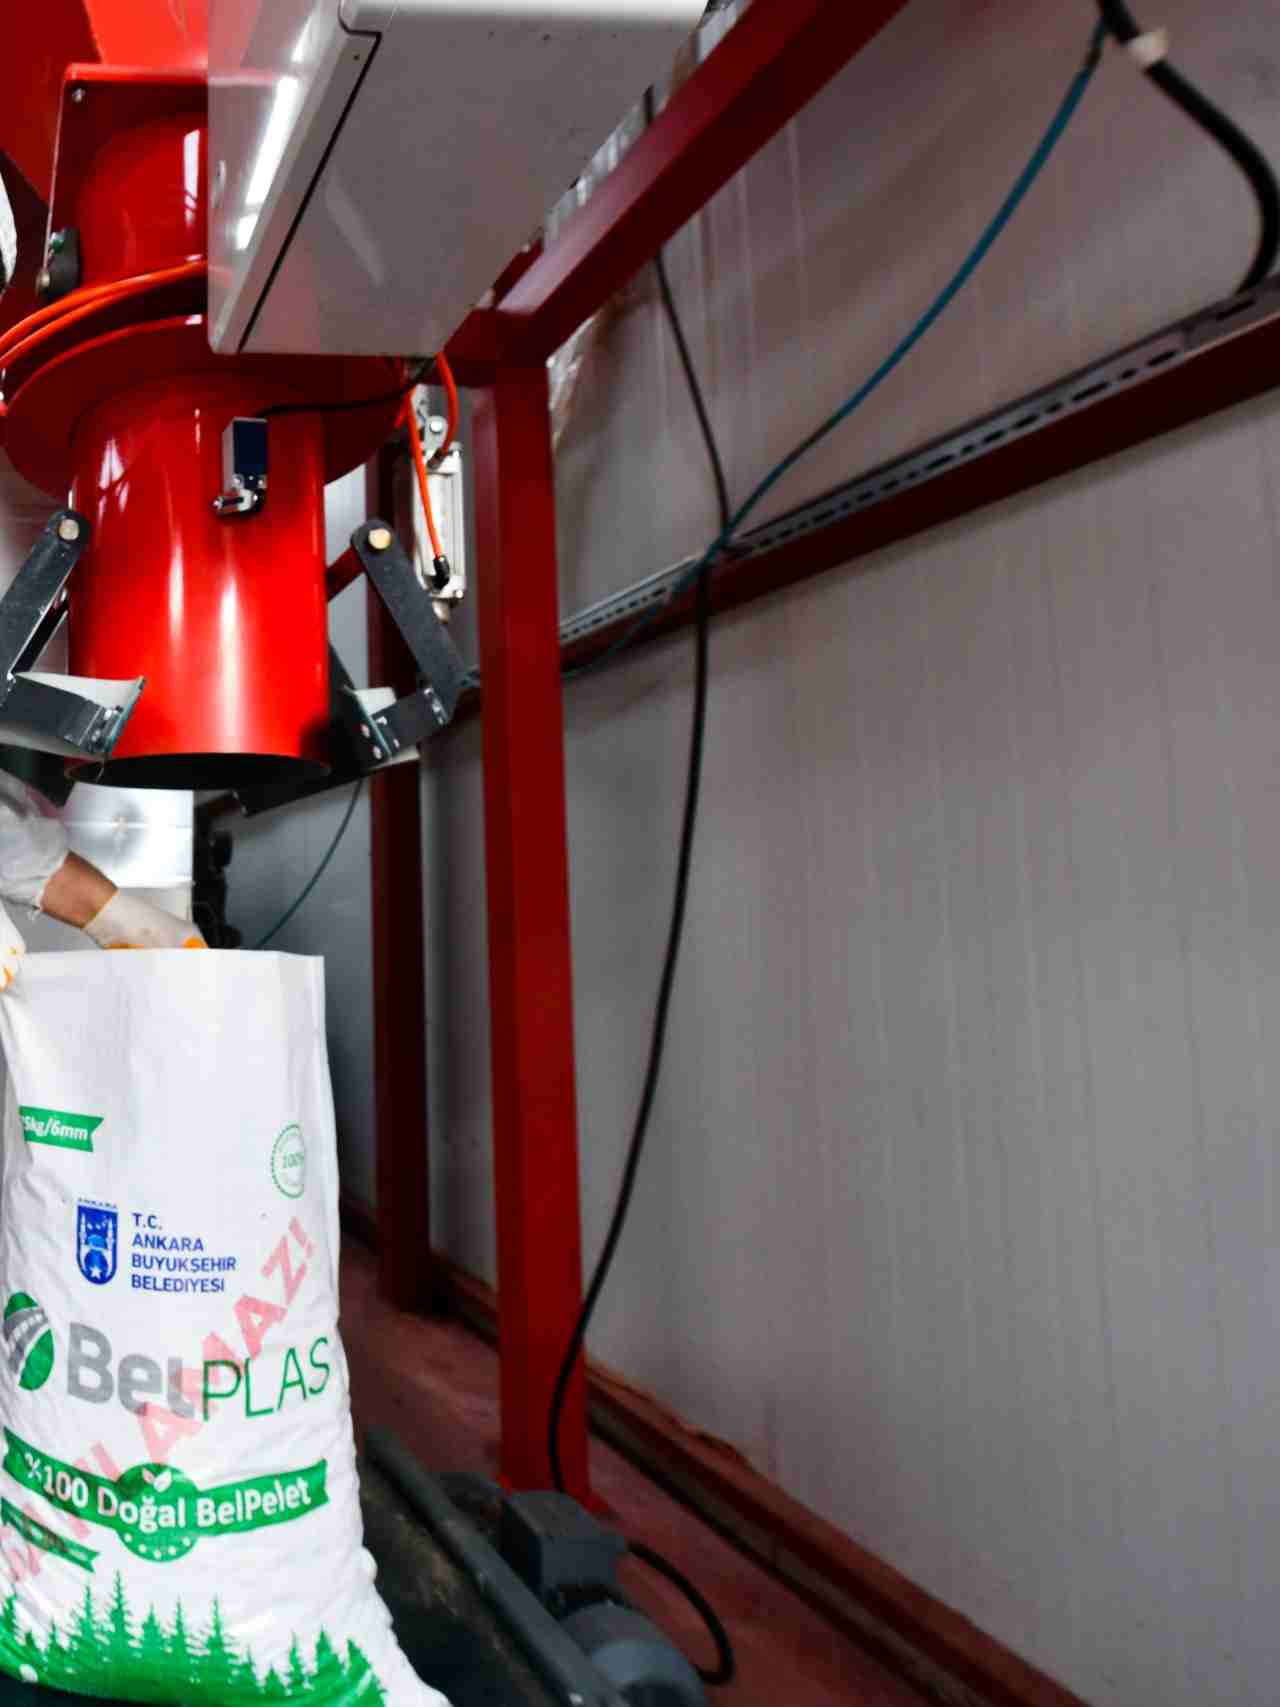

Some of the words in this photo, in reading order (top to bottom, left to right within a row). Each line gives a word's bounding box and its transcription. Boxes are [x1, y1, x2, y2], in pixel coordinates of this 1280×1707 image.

[20, 1115, 88, 1141] 5kg/6mm
[132, 1213, 162, 1230] T.C.
[132, 1232, 203, 1251] ANKARA
[97, 1486, 186, 1533] Doğal
[196, 1477, 312, 1527] BelPelet
